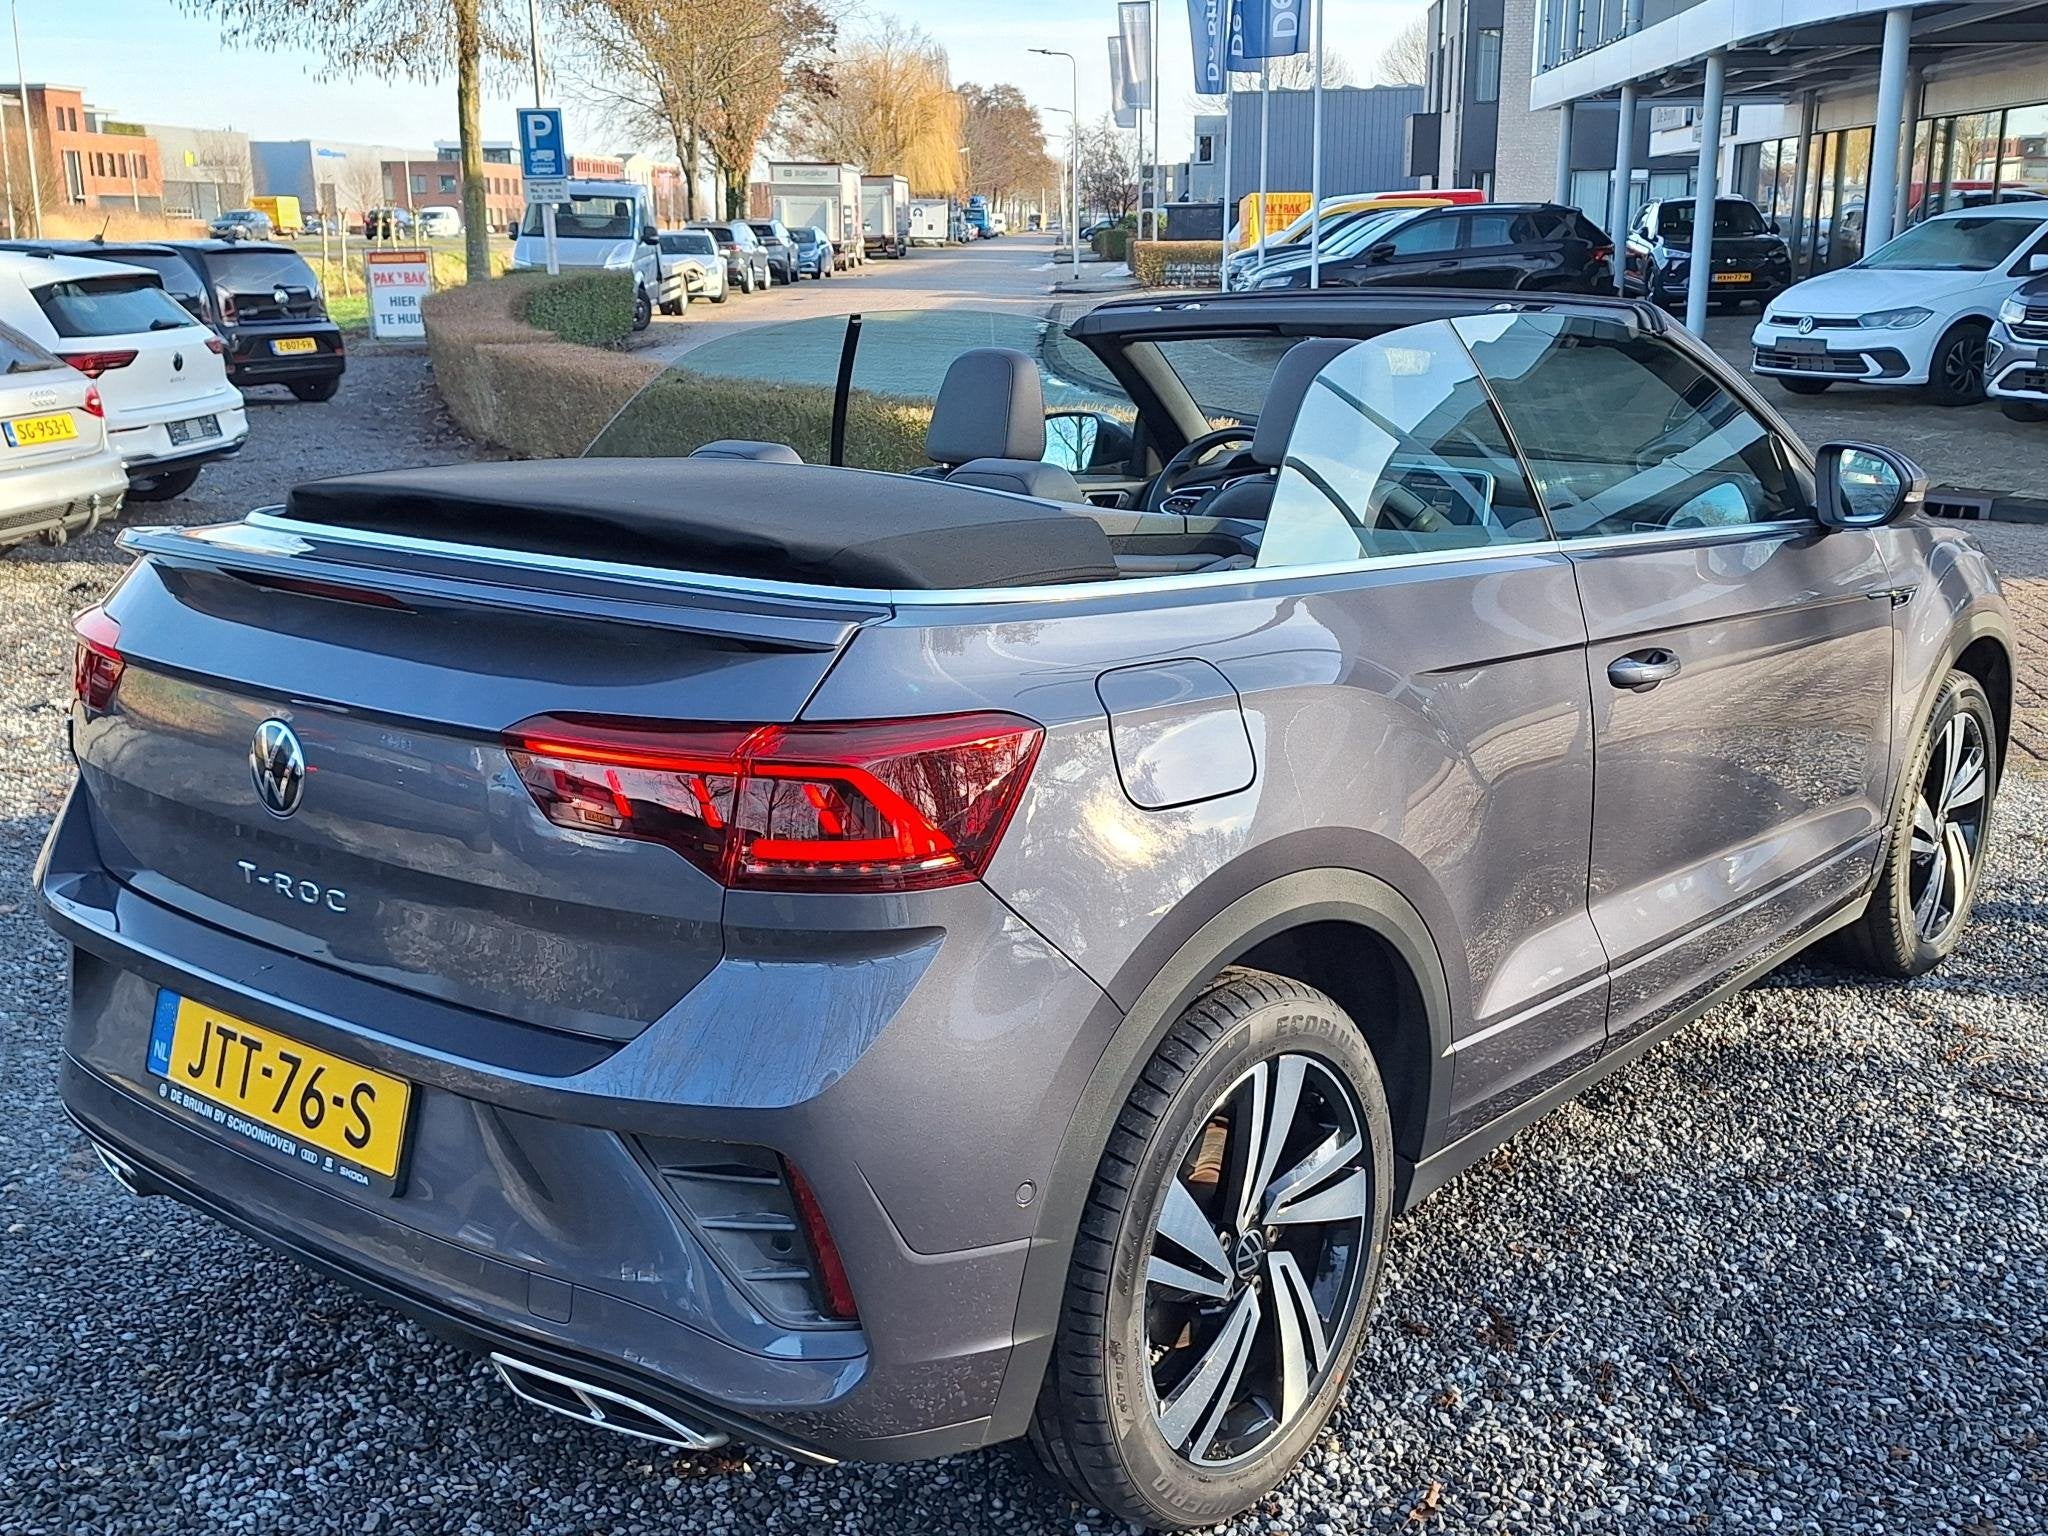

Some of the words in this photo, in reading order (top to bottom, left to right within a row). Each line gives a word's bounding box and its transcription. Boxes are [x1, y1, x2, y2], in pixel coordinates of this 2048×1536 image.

[1231, 14, 1243, 56] De
[527, 114, 552, 149] P
[373, 272, 395, 284] PAK
[404, 271, 426, 284] BAK
[390, 296, 416, 307] HIER
[380, 313, 394, 325] TE
[397, 313, 424, 324] HUU
[16, 418, 71, 440] SG-953-L
[237, 860, 347, 912] T-ROC
[153, 1040, 168, 1062] NL
[187, 1021, 376, 1149] JTT-76-S
[170, 1088, 182, 1104] DE
[182, 1094, 214, 1119] BRUIJN
[214, 1108, 227, 1125] BV
[227, 1114, 297, 1156] SCHOONHOVEN
